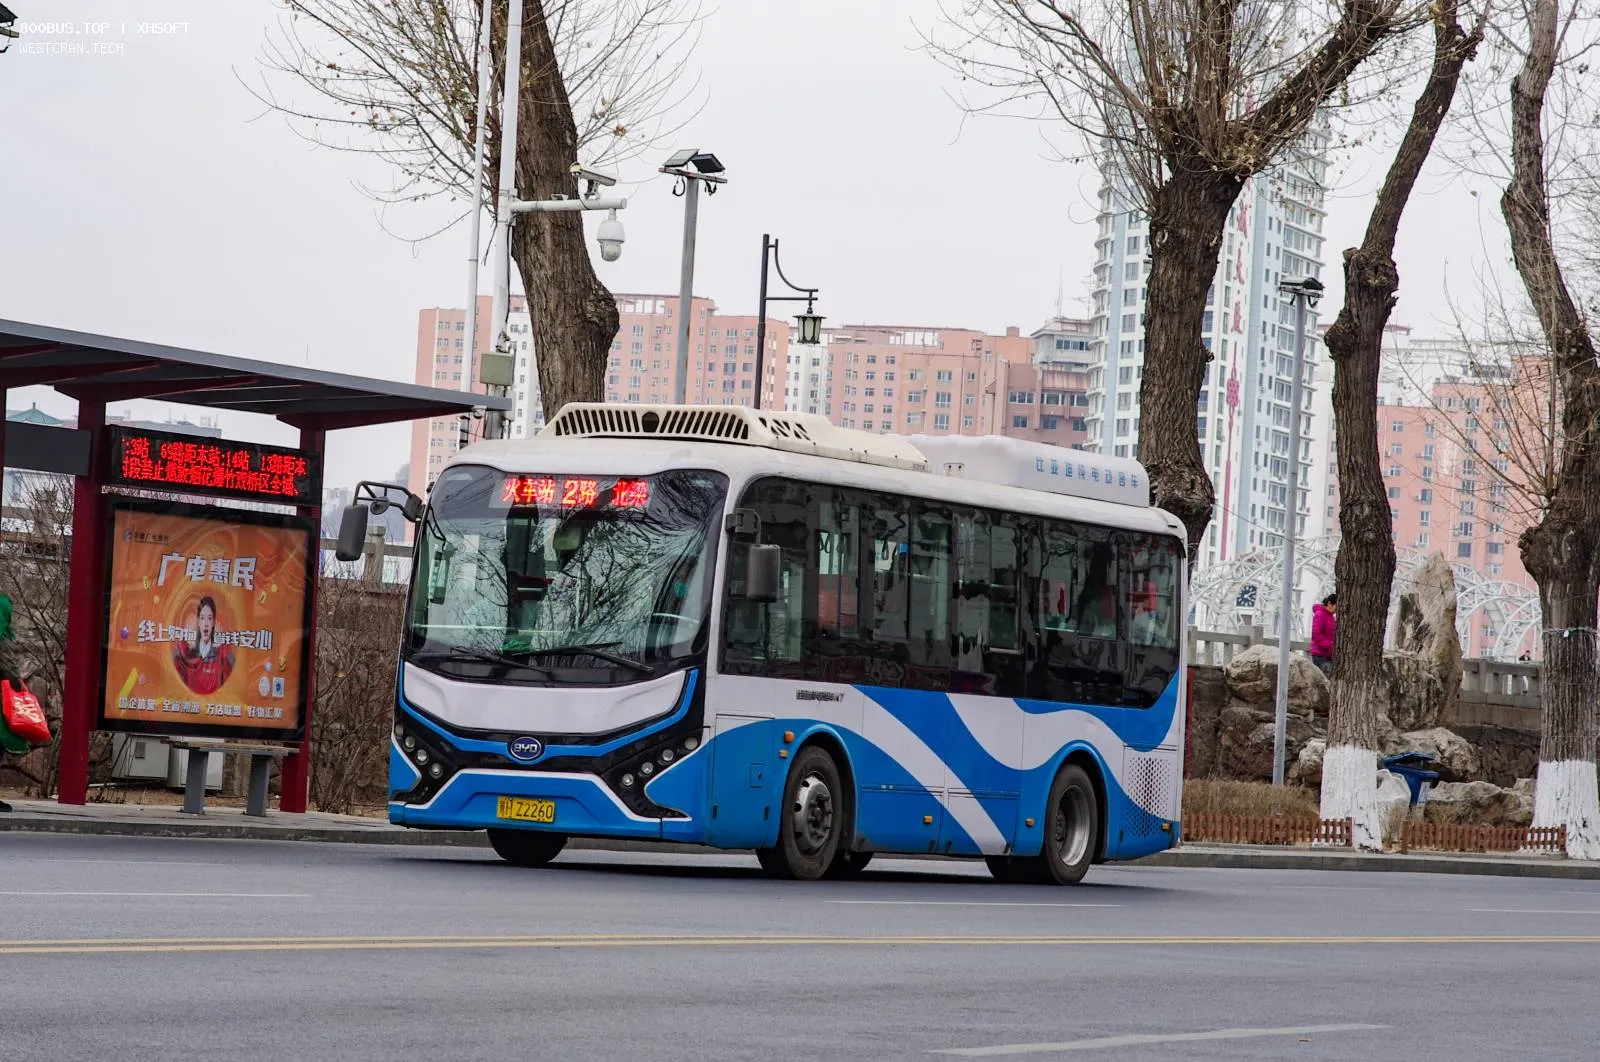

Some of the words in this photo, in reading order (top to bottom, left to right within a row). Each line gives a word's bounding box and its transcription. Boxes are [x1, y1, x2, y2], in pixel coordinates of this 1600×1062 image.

[503, 478, 556, 503] 火车站
[562, 479, 597, 506] 2路
[611, 480, 650, 507] 北梁
[157, 552, 257, 590] 广电惠民
[137, 620, 198, 643] 线上购物
[514, 743, 538, 752] BYD
